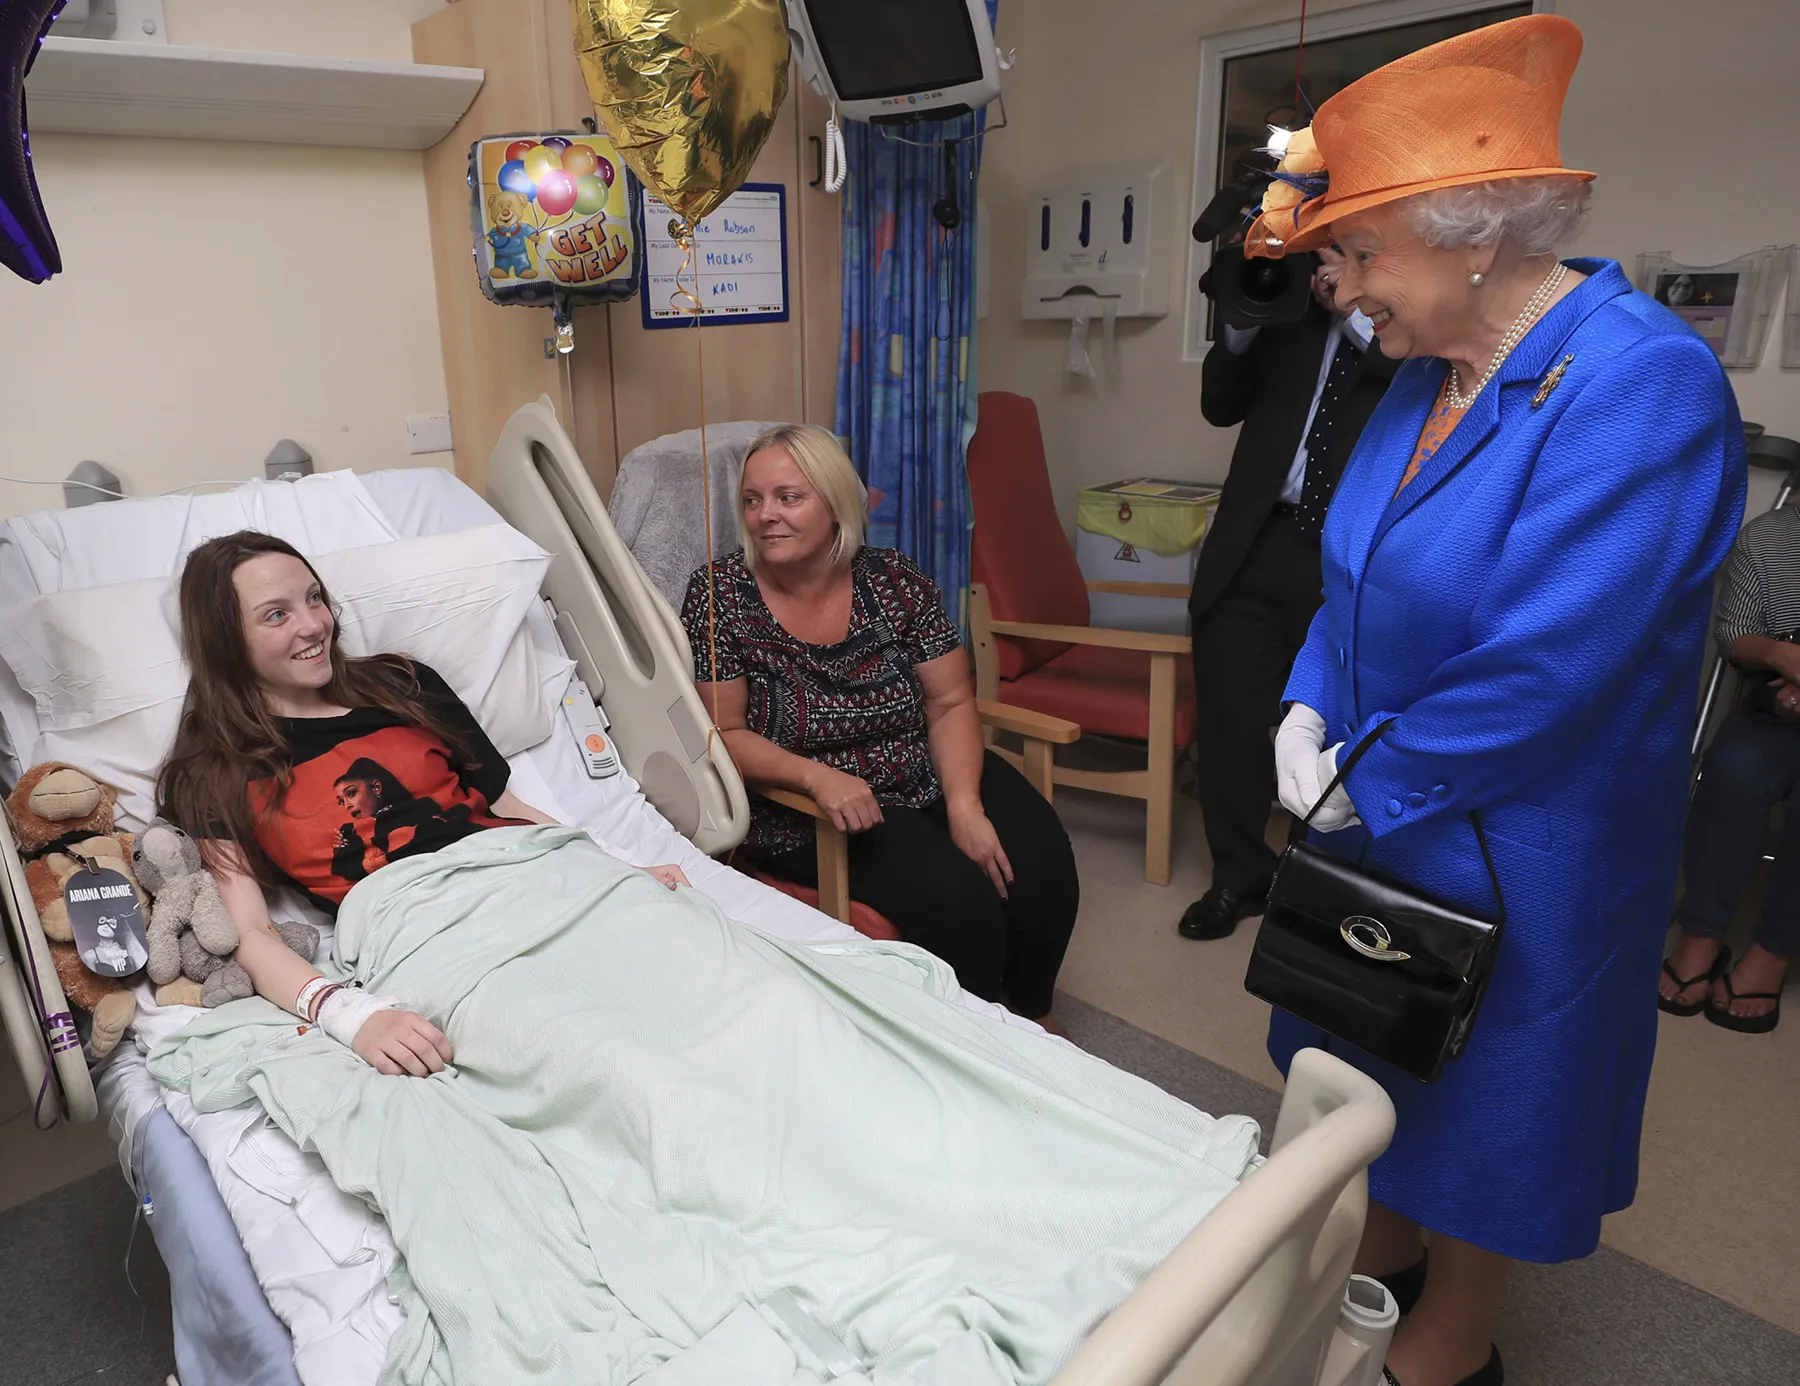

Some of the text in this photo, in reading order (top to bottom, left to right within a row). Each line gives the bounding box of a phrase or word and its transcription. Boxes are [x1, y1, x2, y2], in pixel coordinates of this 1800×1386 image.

[550, 211, 607, 256] GET
[723, 219, 756, 234] Robson
[545, 234, 628, 283] WELL
[69, 884, 133, 903] ARIANA GRANDE
[111, 958, 127, 973] VIP
